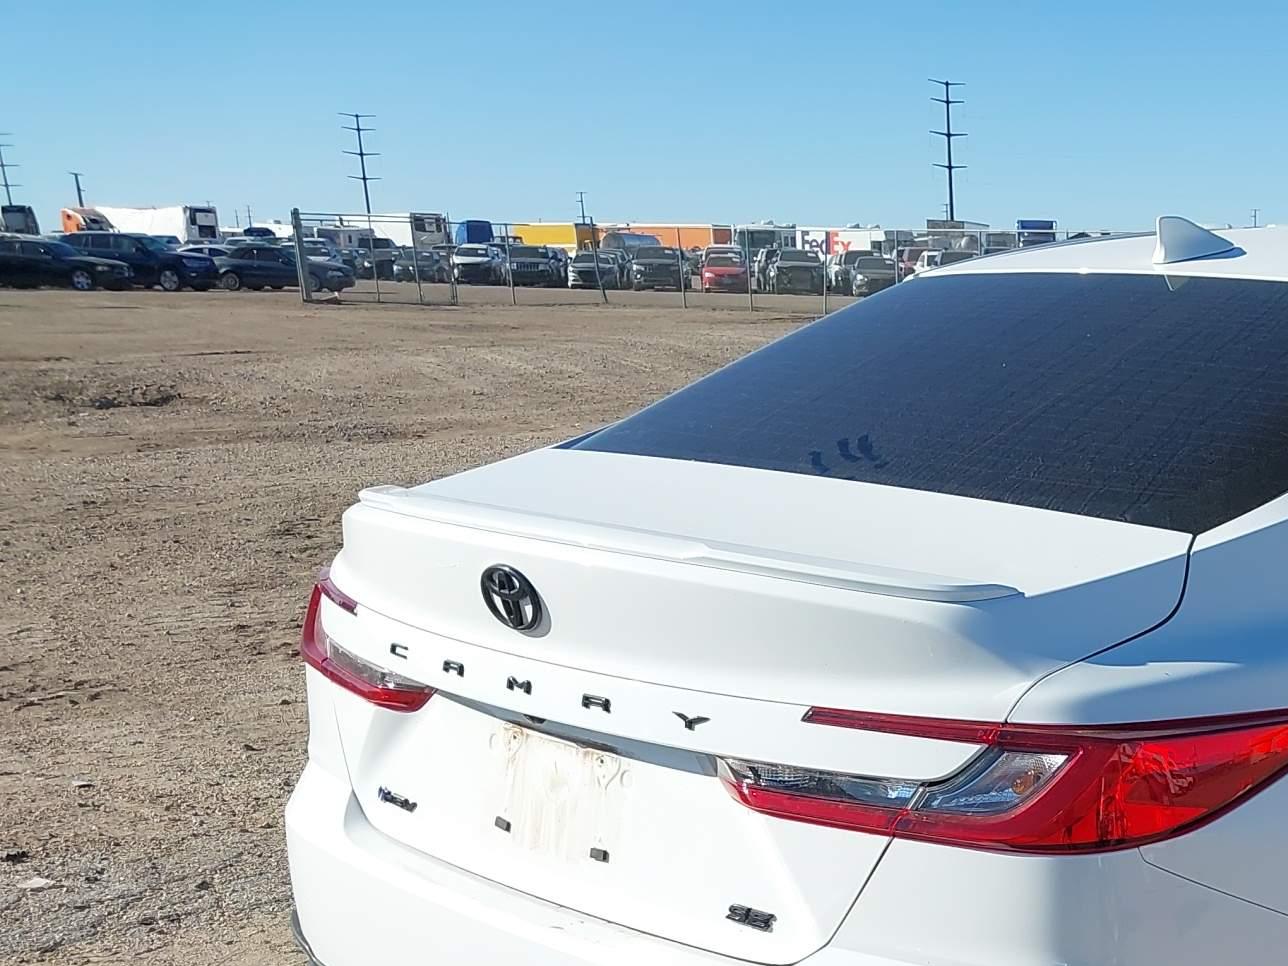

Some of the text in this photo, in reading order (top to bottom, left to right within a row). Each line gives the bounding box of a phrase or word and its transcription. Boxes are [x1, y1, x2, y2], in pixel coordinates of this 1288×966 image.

[801, 230, 851, 255] FedEx
[390, 643, 711, 731] CAMRY
[725, 903, 778, 933] SE
